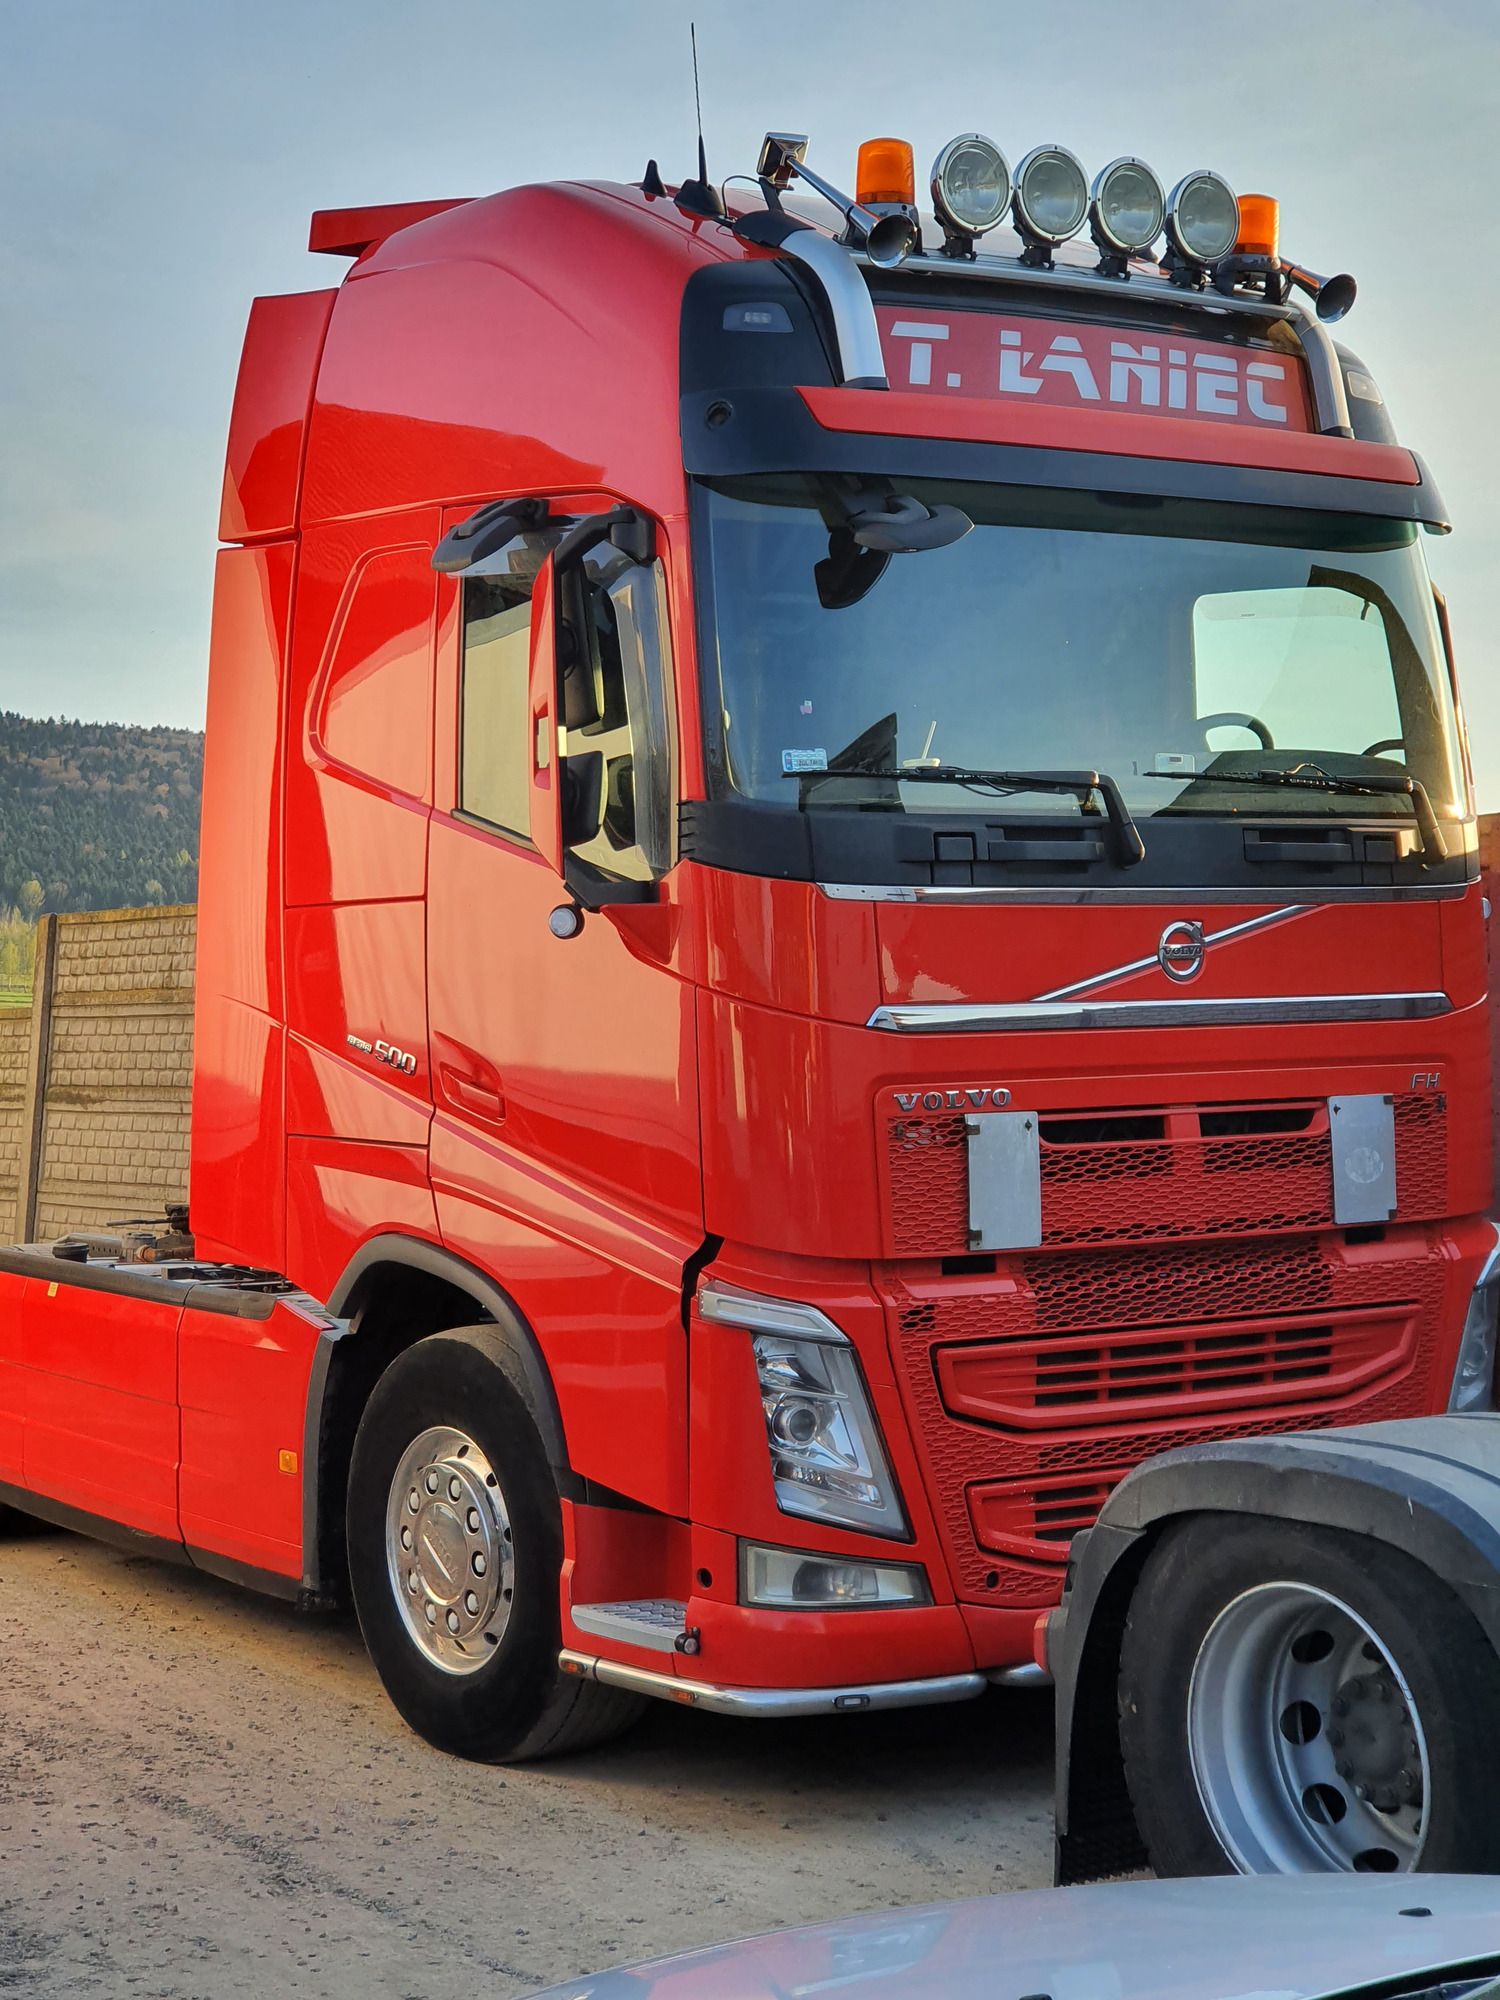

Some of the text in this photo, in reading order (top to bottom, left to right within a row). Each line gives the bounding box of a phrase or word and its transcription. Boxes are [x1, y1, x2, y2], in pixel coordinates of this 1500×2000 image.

[890, 321, 961, 388] T.
[375, 1039, 417, 1076] 500
[1411, 1072, 1441, 1089] FH
[893, 1087, 1012, 1112] VOLVO
